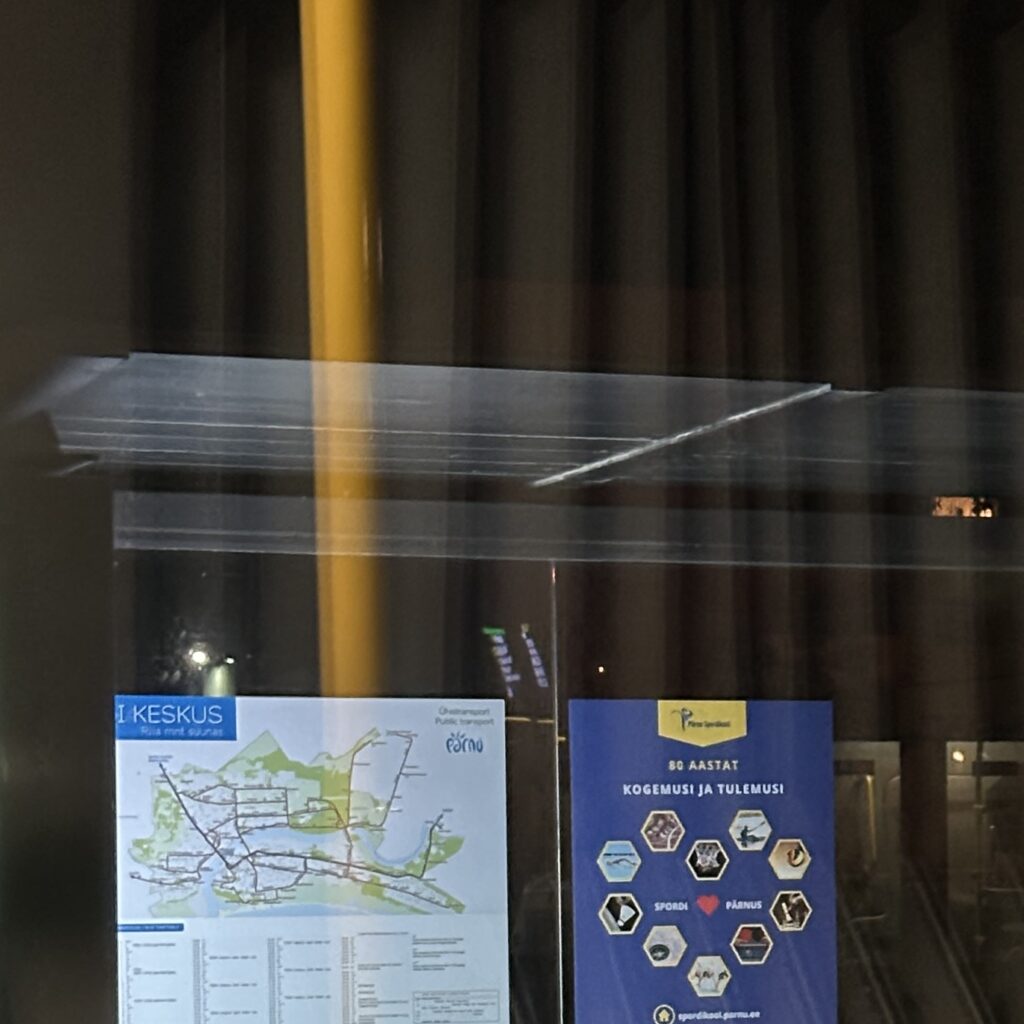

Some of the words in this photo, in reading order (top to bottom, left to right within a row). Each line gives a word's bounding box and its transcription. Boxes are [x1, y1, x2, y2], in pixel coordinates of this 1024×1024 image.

[132, 704, 223, 724] KESKUS
[435, 717, 458, 726] Public
[460, 717, 495, 727] transport
[668, 760, 684, 771] 80
[688, 760, 739, 771] AASTAT
[622, 784, 695, 795] KOGEMUSI
[698, 784, 714, 797] JA
[717, 783, 785, 795] TULEMUSI
[654, 902, 689, 912] SPORDI
[725, 900, 763, 911] PÄRNUS
